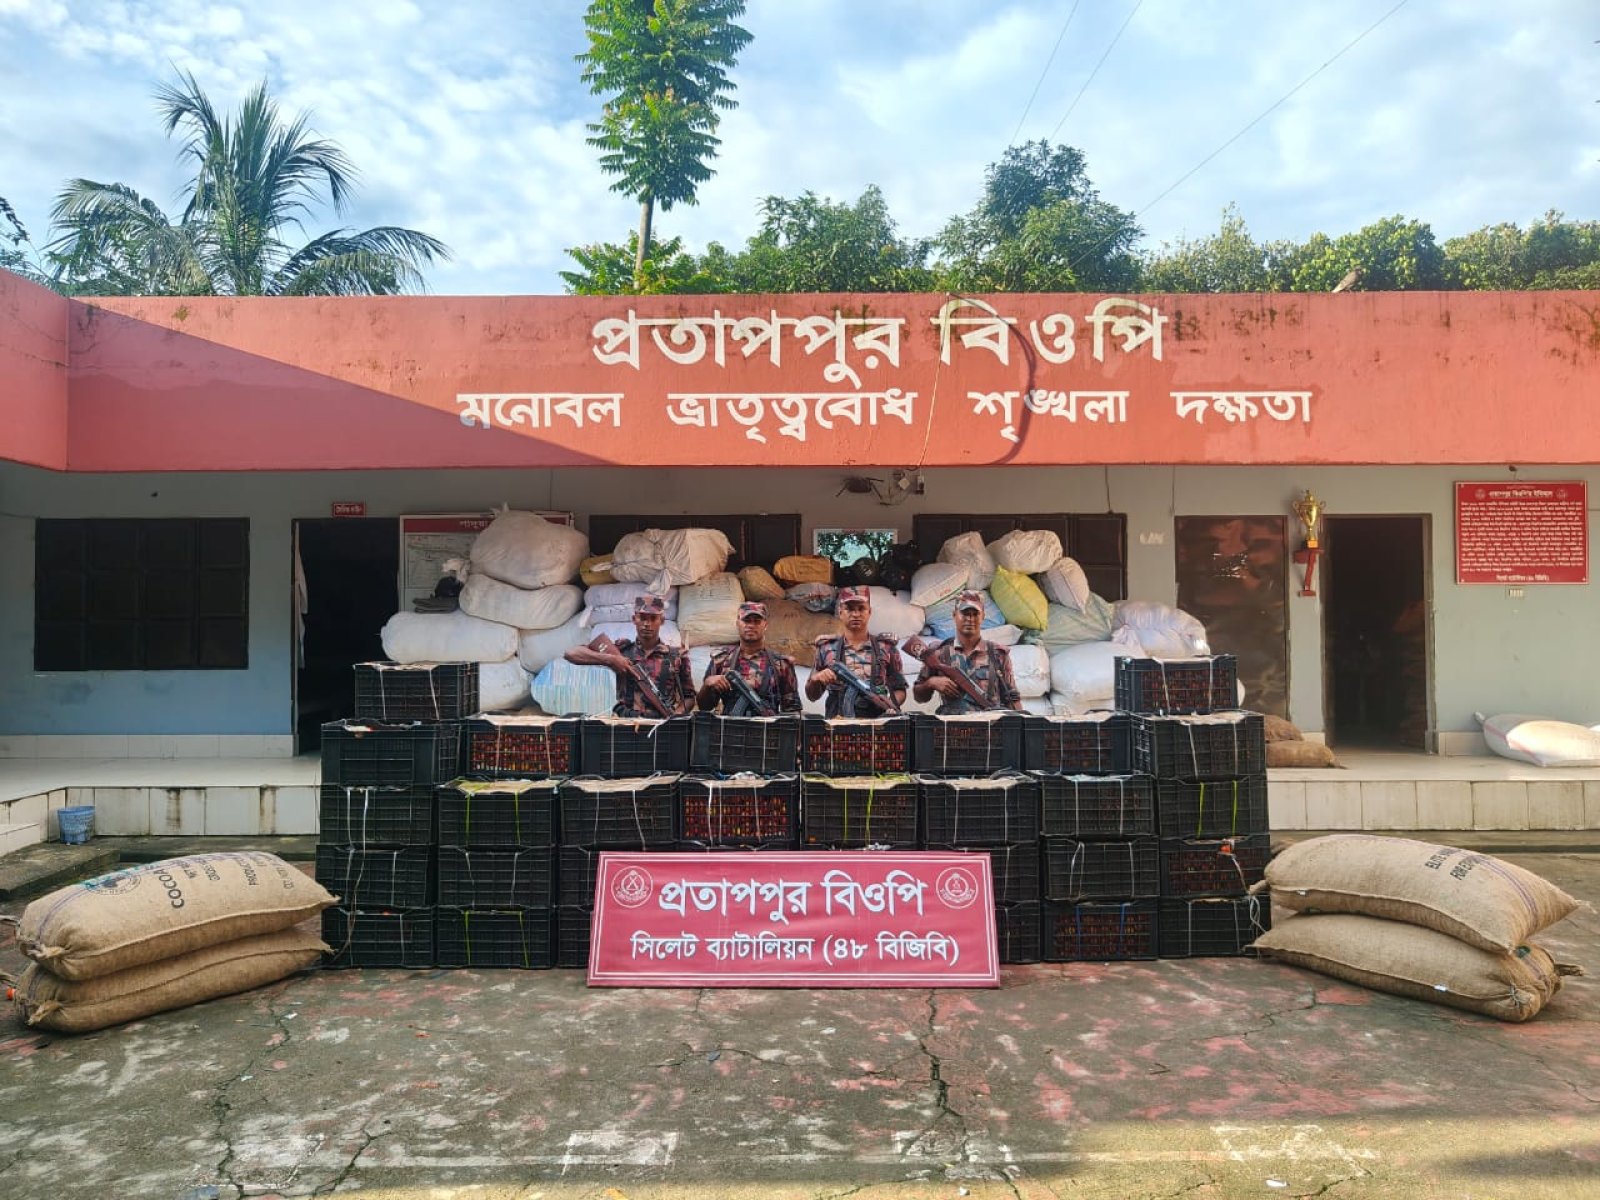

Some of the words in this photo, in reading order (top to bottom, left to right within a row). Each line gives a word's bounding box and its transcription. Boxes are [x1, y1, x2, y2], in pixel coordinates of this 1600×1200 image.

[591, 309, 906, 389] প্রতাপপুর
[930, 297, 1169, 366] বিওপি
[456, 392, 624, 429] মনোবল
[666, 387, 918, 443] ভ্রাতৃত্ববোধ
[966, 389, 1130, 443] শৃঙ্খলা
[1170, 390, 1313, 424] দক্ষতা
[153, 868, 185, 908] COCOA
[658, 876, 812, 925] প্রতাপপুর
[821, 869, 928, 917] বিওপি
[630, 929, 700, 961] সিলেট
[705, 930, 816, 961] ব্যাটালিয়ন
[822, 935, 868, 967] (৪৮
[875, 929, 960, 967] বিজিবি)
